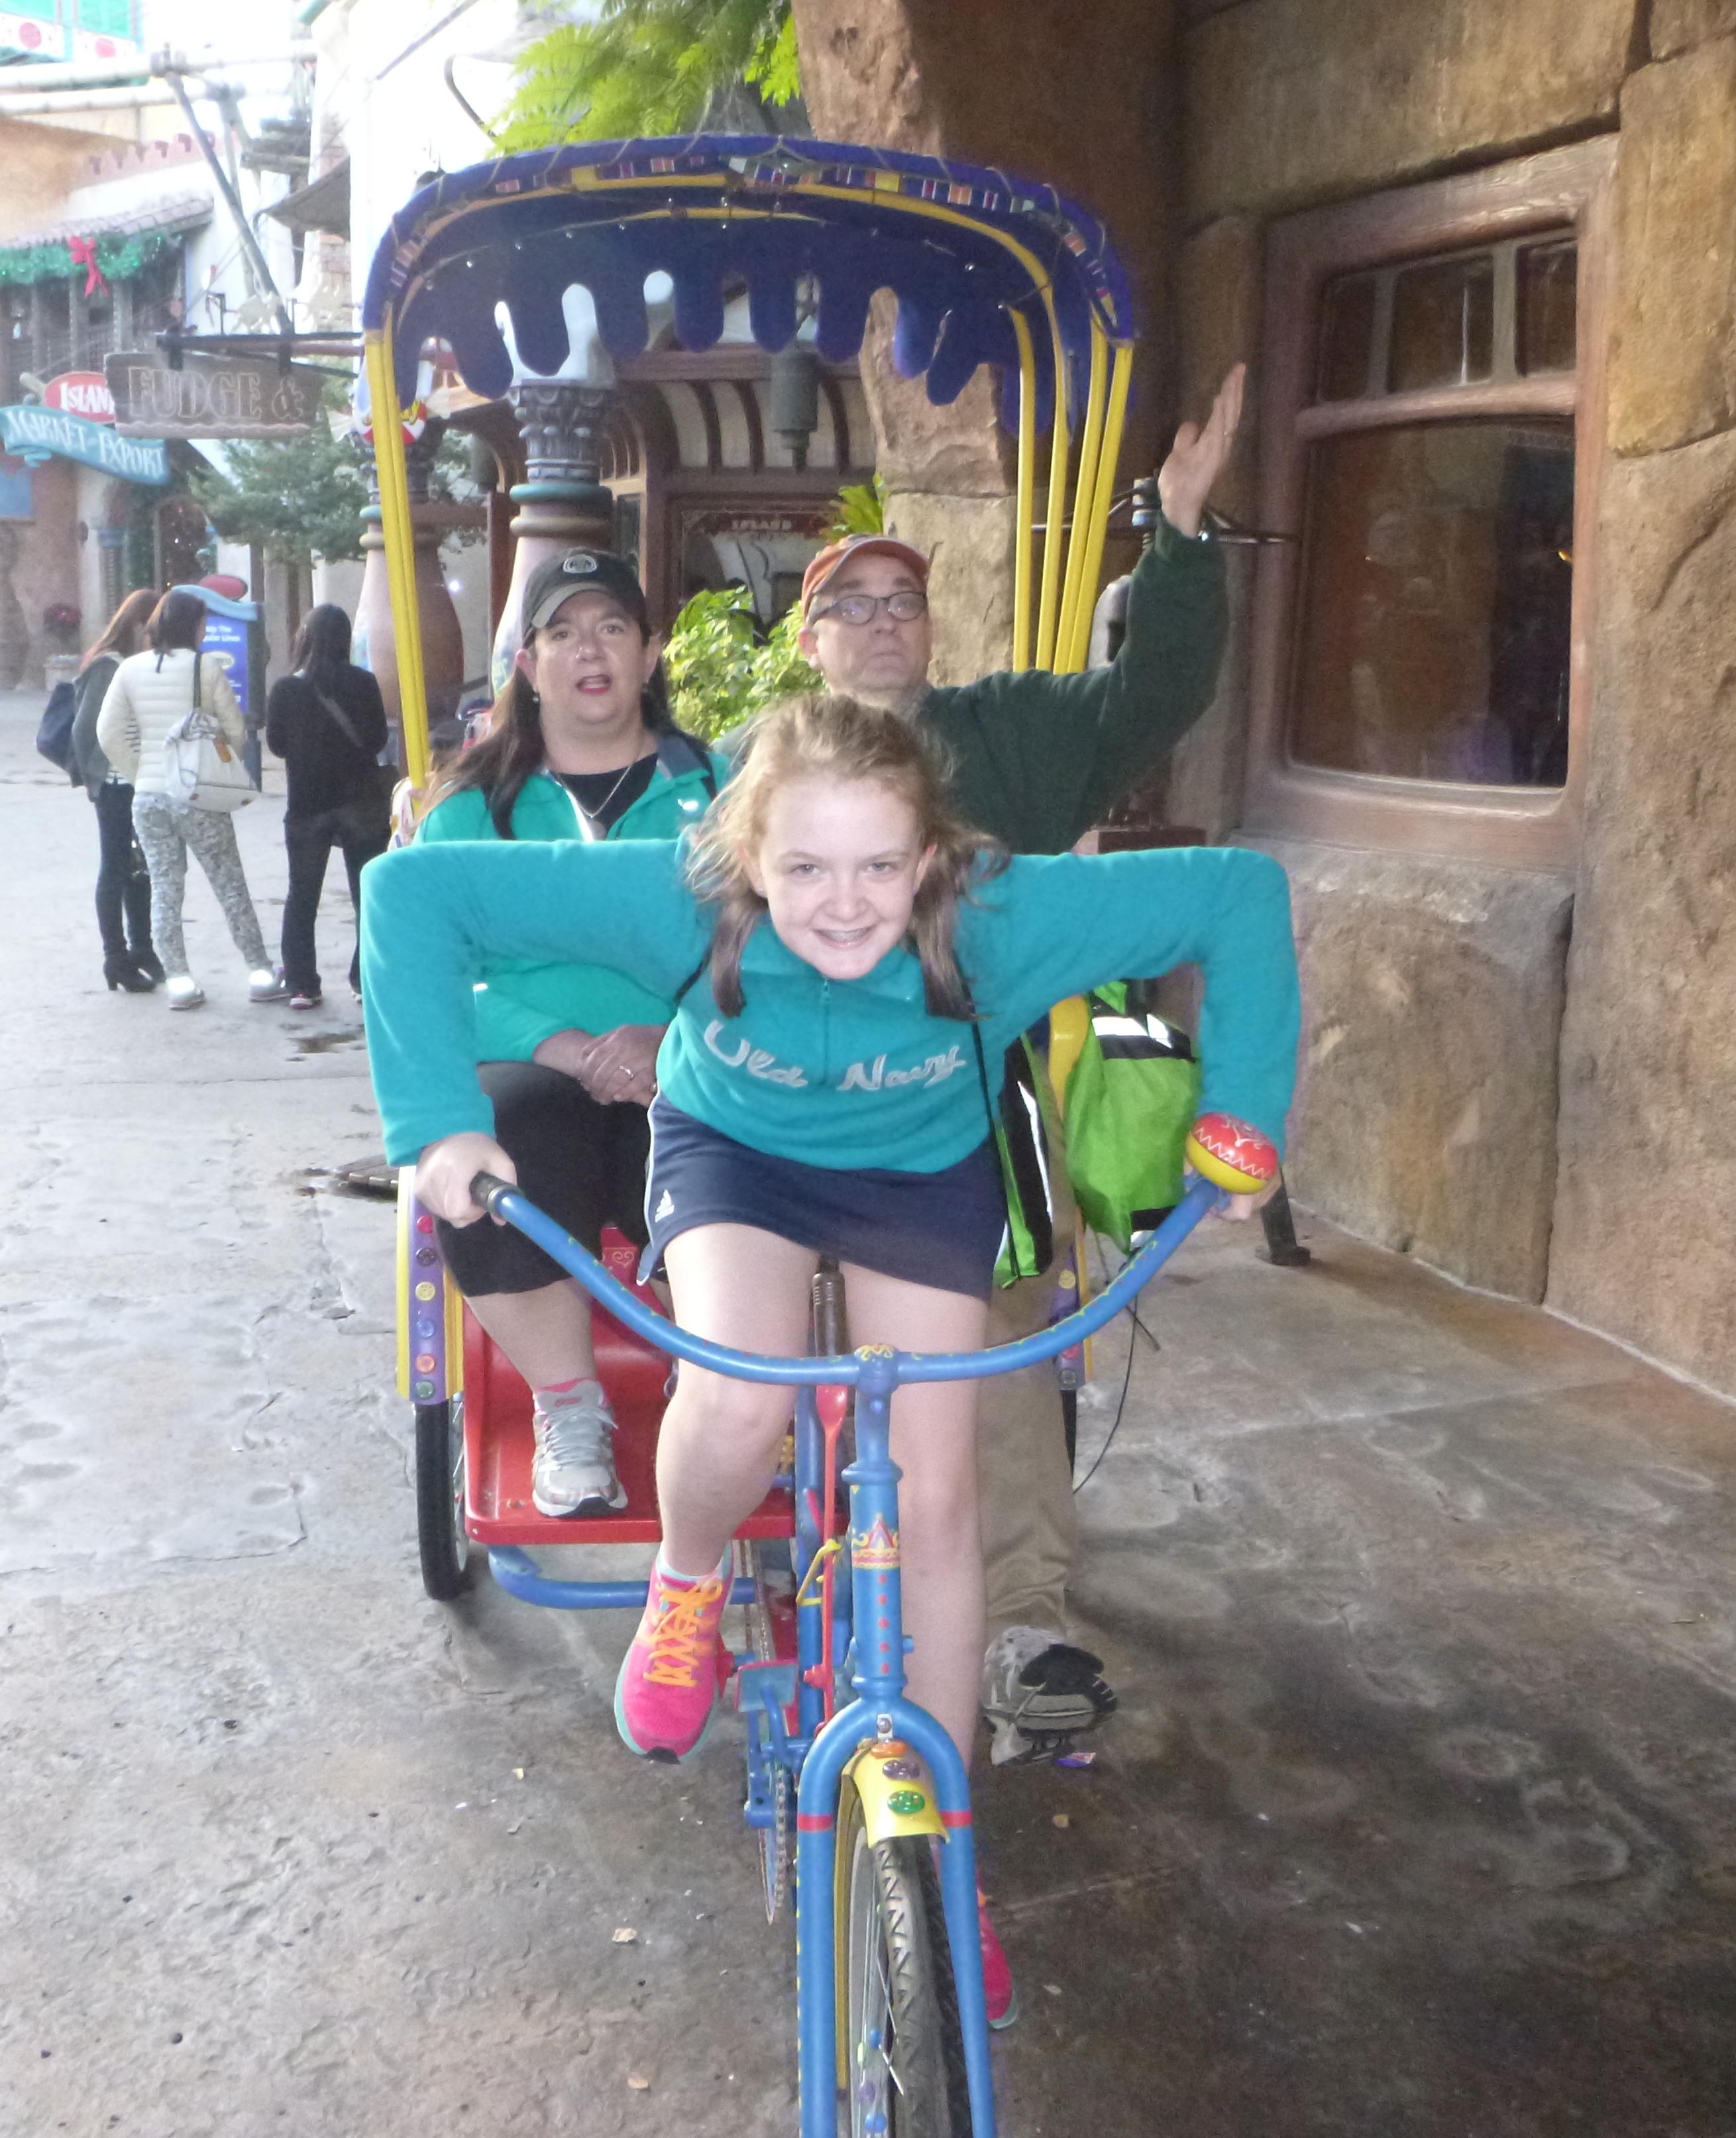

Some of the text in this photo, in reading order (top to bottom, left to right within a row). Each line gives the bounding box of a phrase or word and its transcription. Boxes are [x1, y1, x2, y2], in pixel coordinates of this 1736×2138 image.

[129, 366, 305, 421] FUDGE &
[5, 409, 165, 480] MARKET EXPORT
